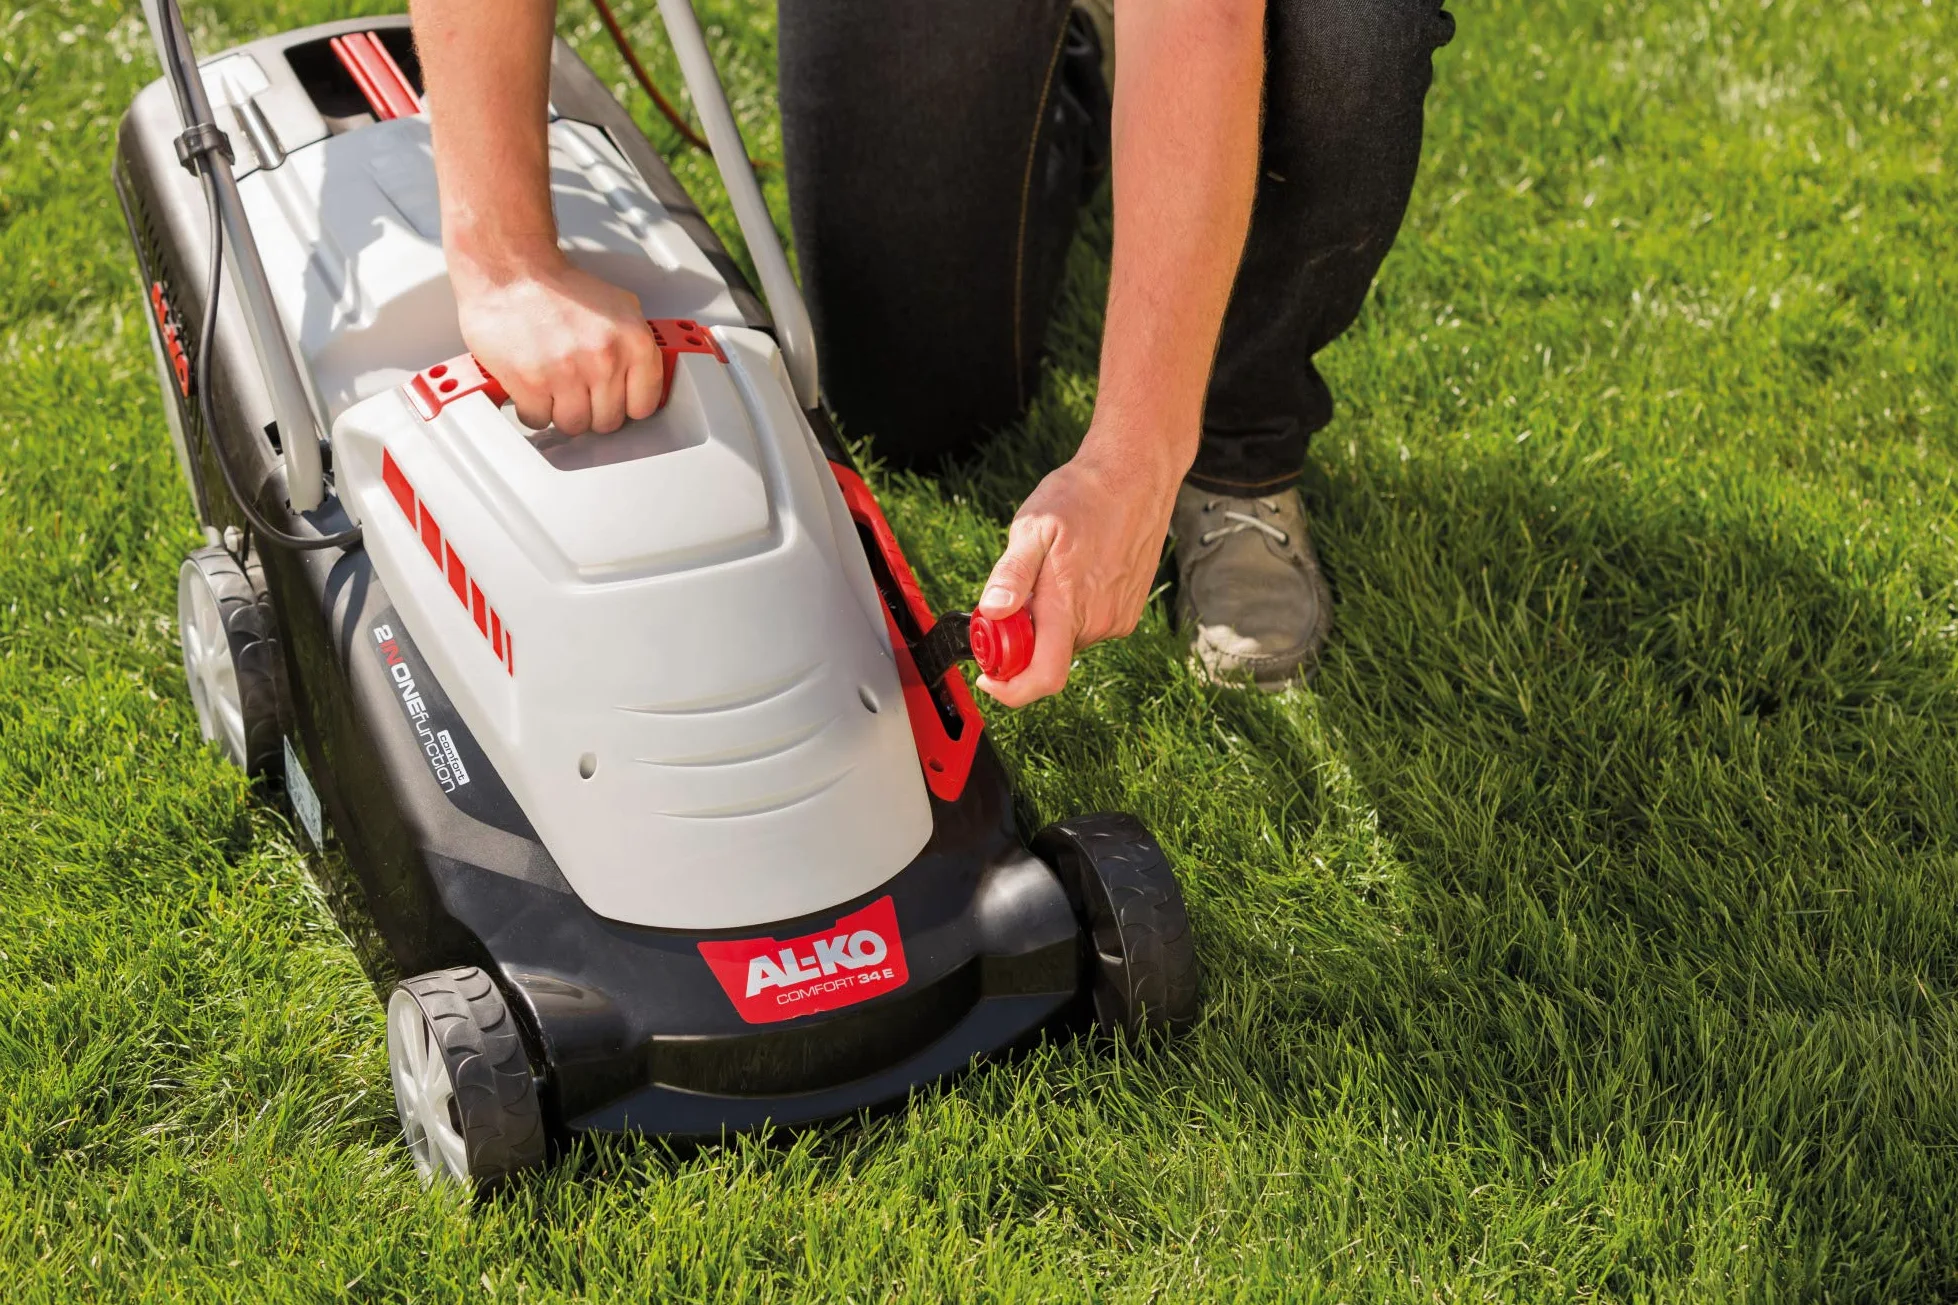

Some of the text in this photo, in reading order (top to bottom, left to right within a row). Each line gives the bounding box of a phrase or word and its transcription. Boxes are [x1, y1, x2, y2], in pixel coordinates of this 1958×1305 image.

[440, 734, 465, 781] comfort
[746, 929, 887, 998] AL-KO
[776, 968, 894, 1005] COMFORT 34 E
